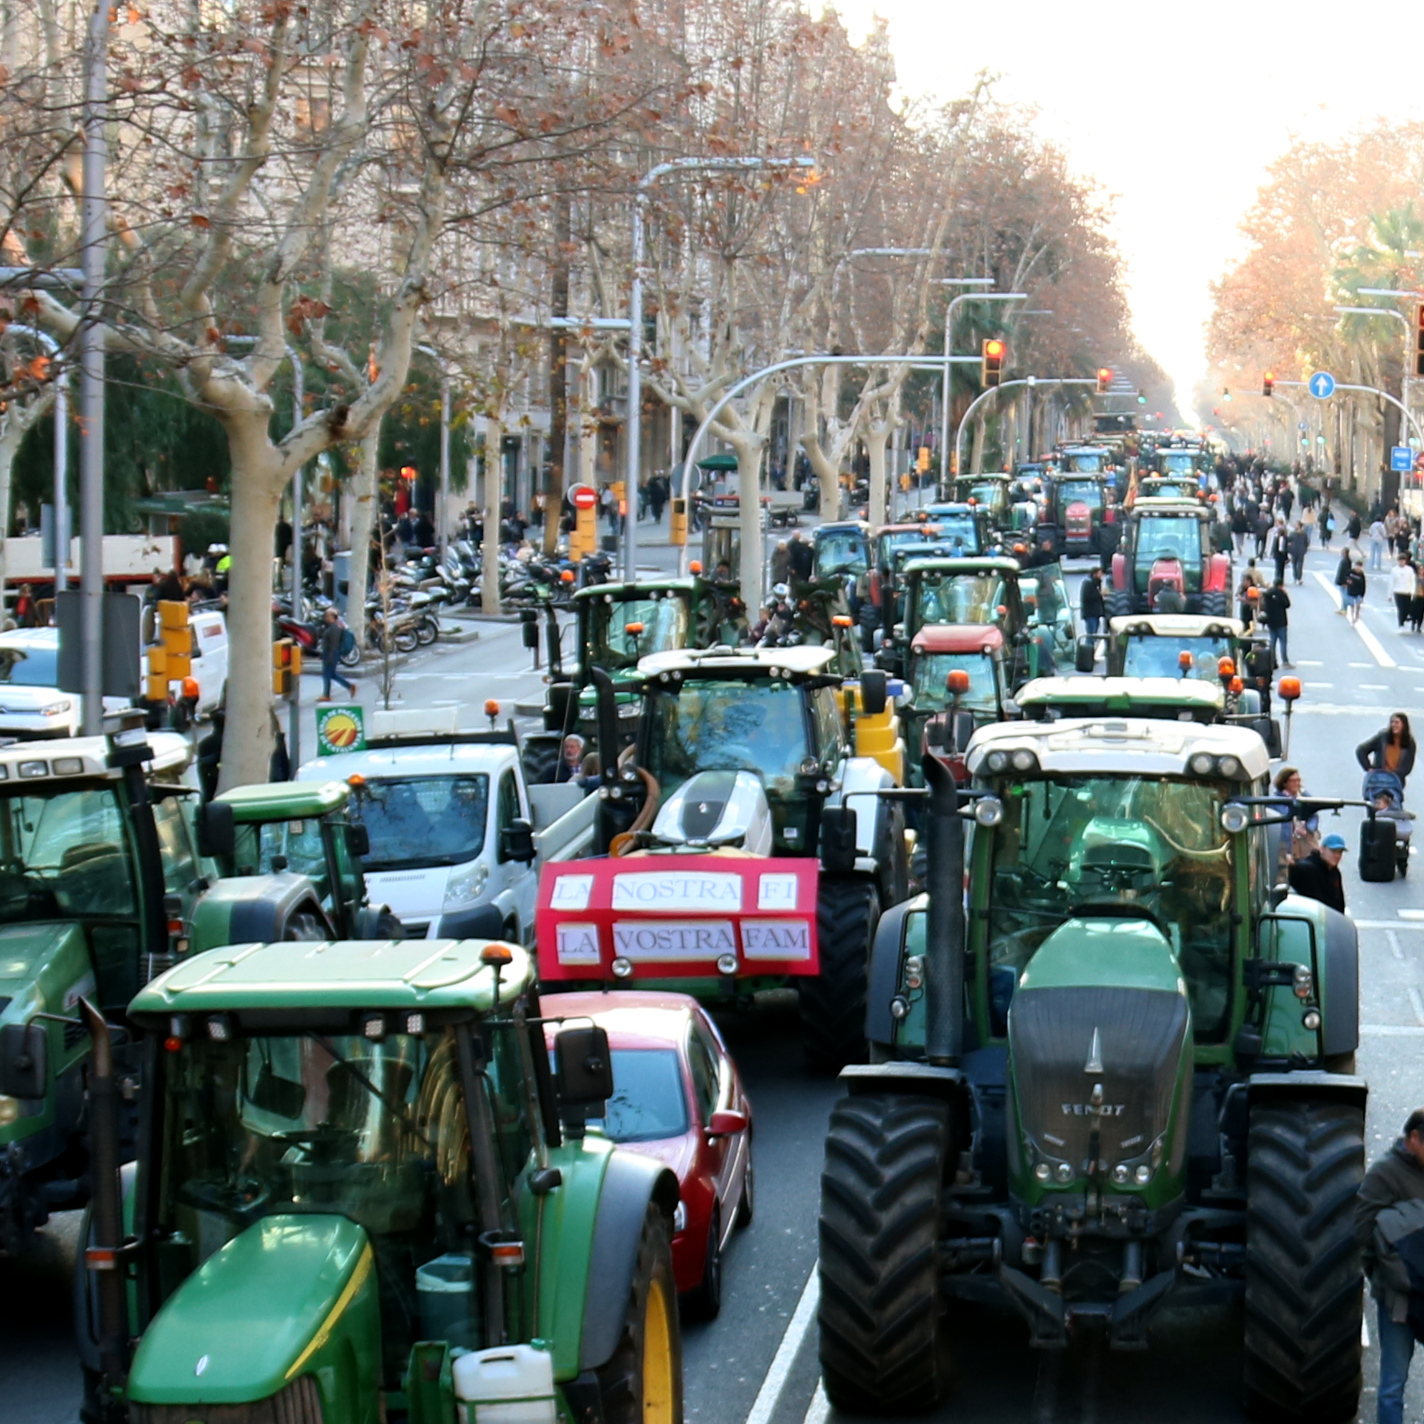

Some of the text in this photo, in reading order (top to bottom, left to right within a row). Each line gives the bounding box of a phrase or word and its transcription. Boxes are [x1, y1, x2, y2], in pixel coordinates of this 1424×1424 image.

[552, 879, 794, 902] LA NOSTRA FI
[559, 928, 808, 953] LA VOSTRA FAM
